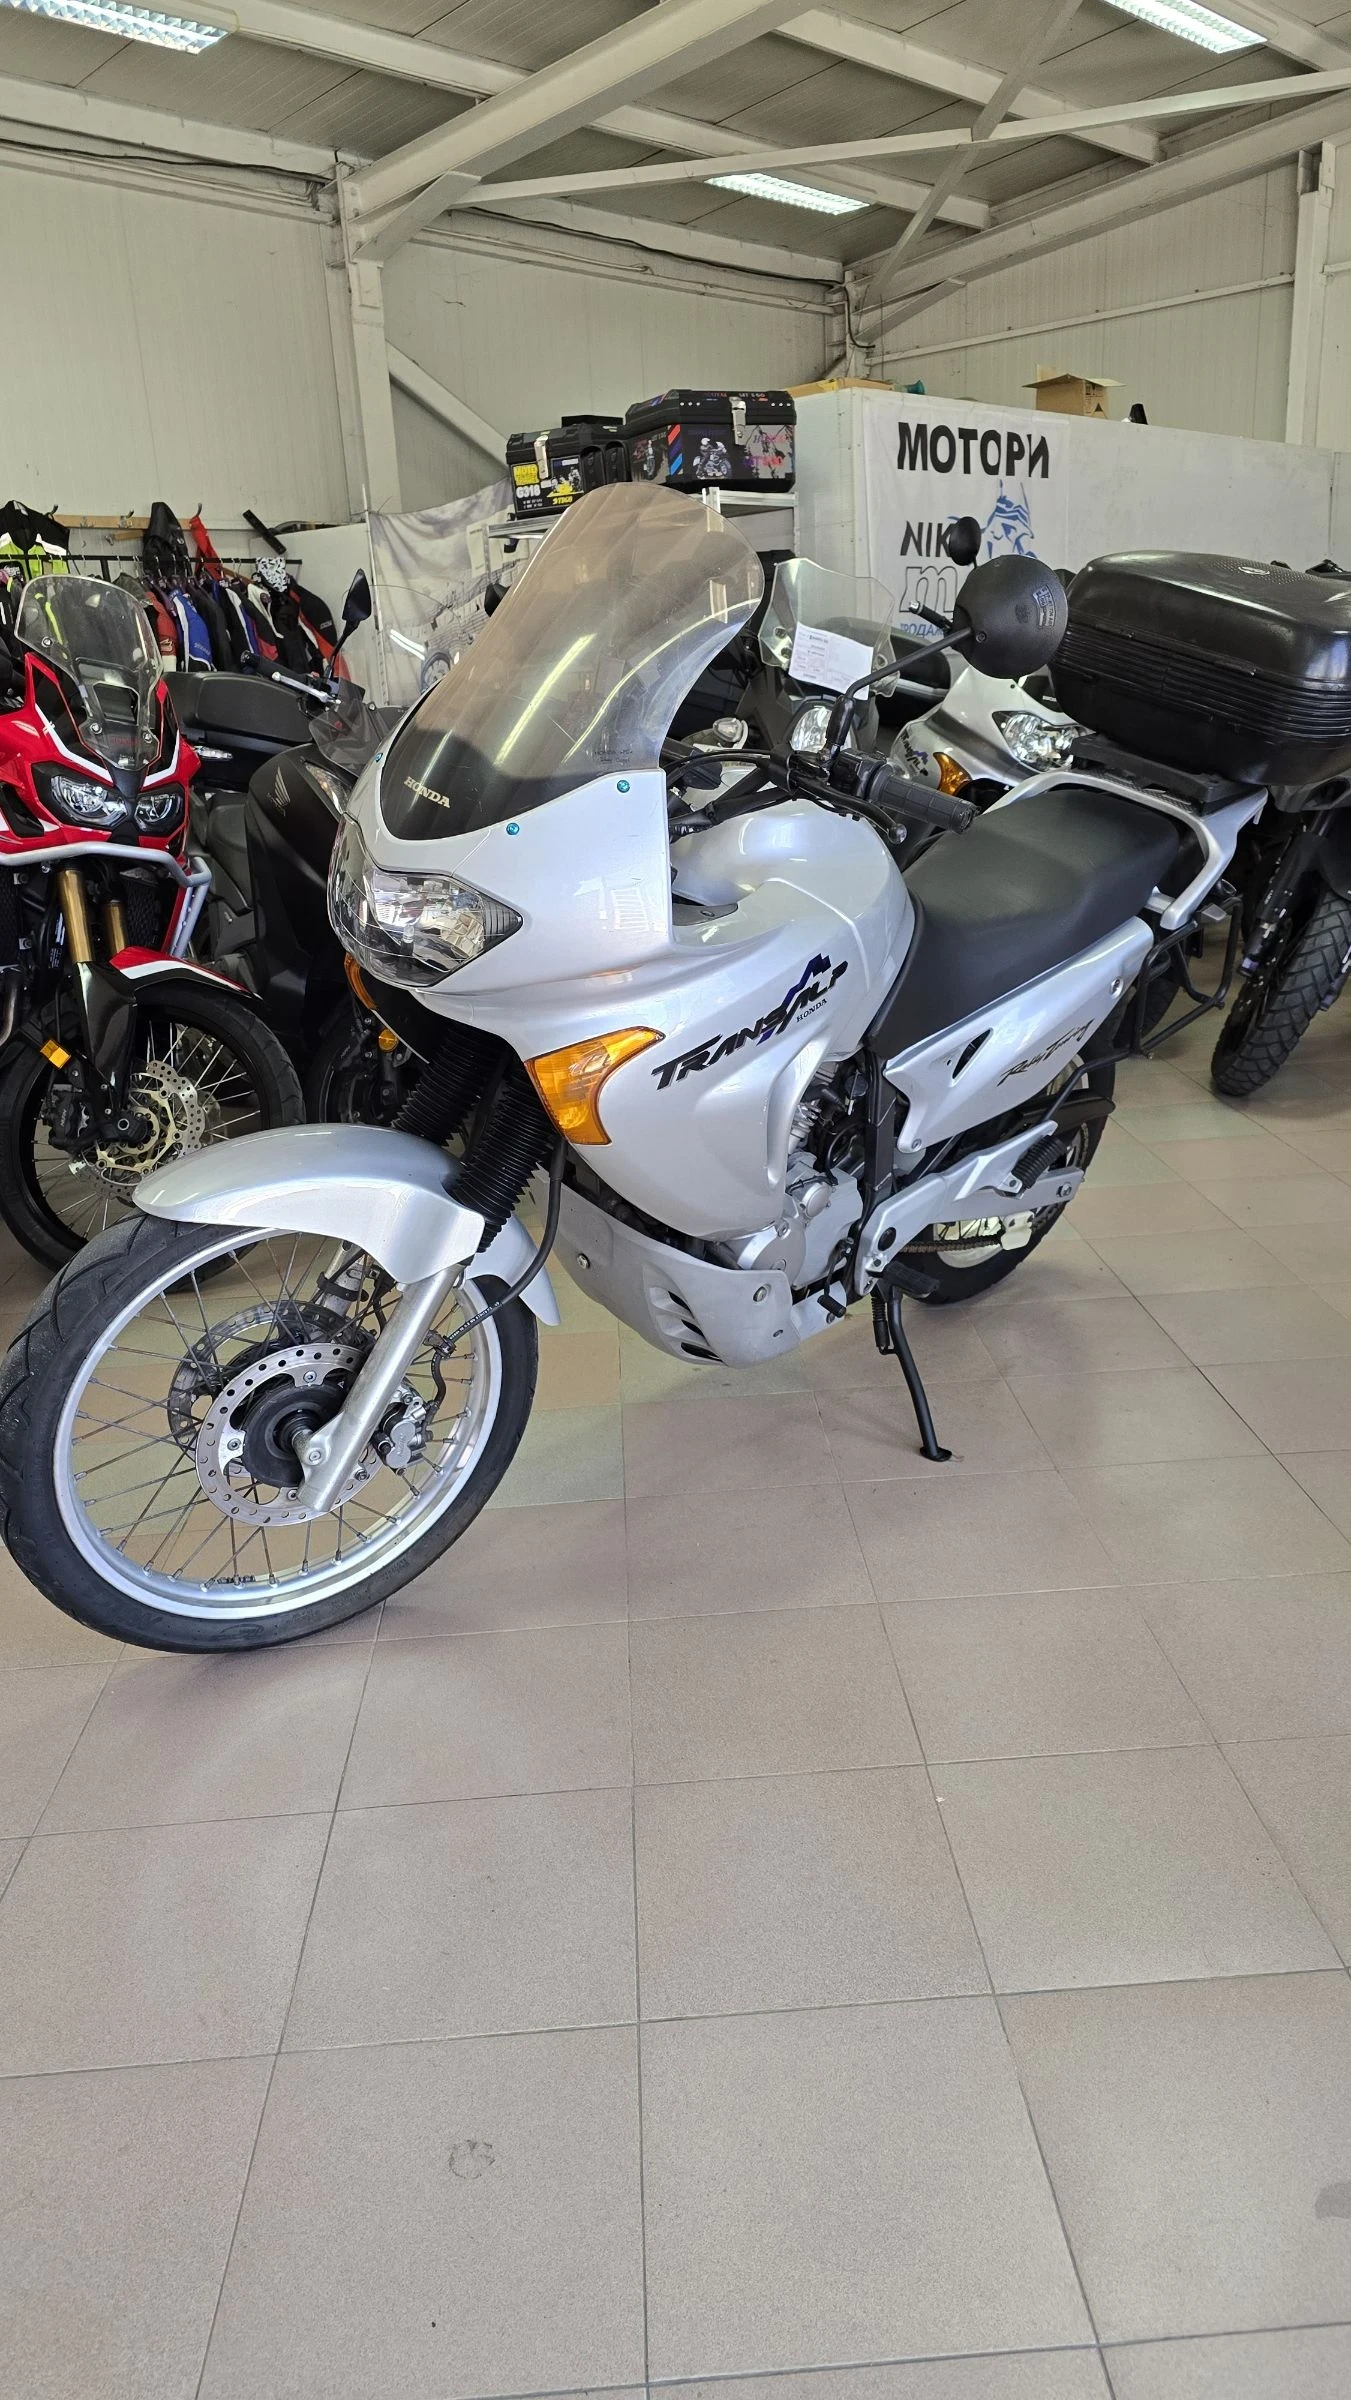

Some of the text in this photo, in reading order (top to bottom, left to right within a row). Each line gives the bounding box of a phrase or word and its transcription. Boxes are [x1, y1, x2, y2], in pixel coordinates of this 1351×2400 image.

[897, 421, 1049, 478] МОТОРИ
[403, 776, 451, 808] HONDA
[651, 953, 849, 1090] TRANSALP
[796, 998, 827, 1022] HONDA
